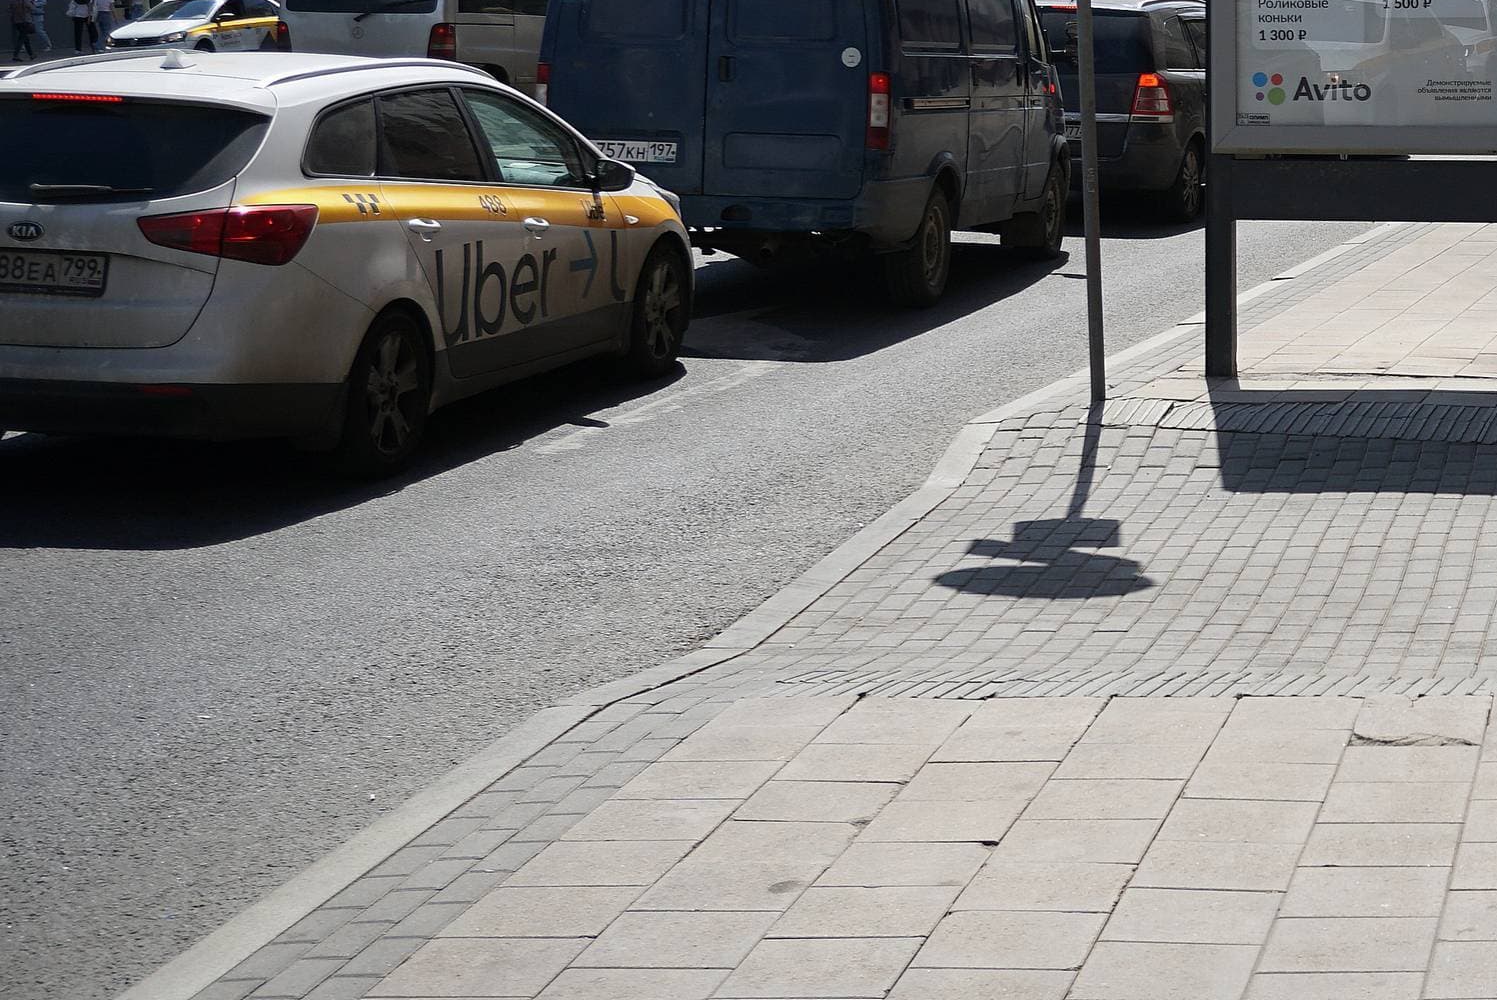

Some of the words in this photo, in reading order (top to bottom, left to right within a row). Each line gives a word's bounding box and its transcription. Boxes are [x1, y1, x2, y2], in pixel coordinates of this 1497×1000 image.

[1259, 13, 1302, 23] коньки
[1259, 30, 1267, 41] 1
[1271, 30, 1294, 41] 300
[1293, 77, 1372, 102] Avito
[650, 143, 673, 156] 197
[12, 225, 38, 237] KIA
[63, 257, 97, 278] 799
[434, 239, 556, 348] Uber
